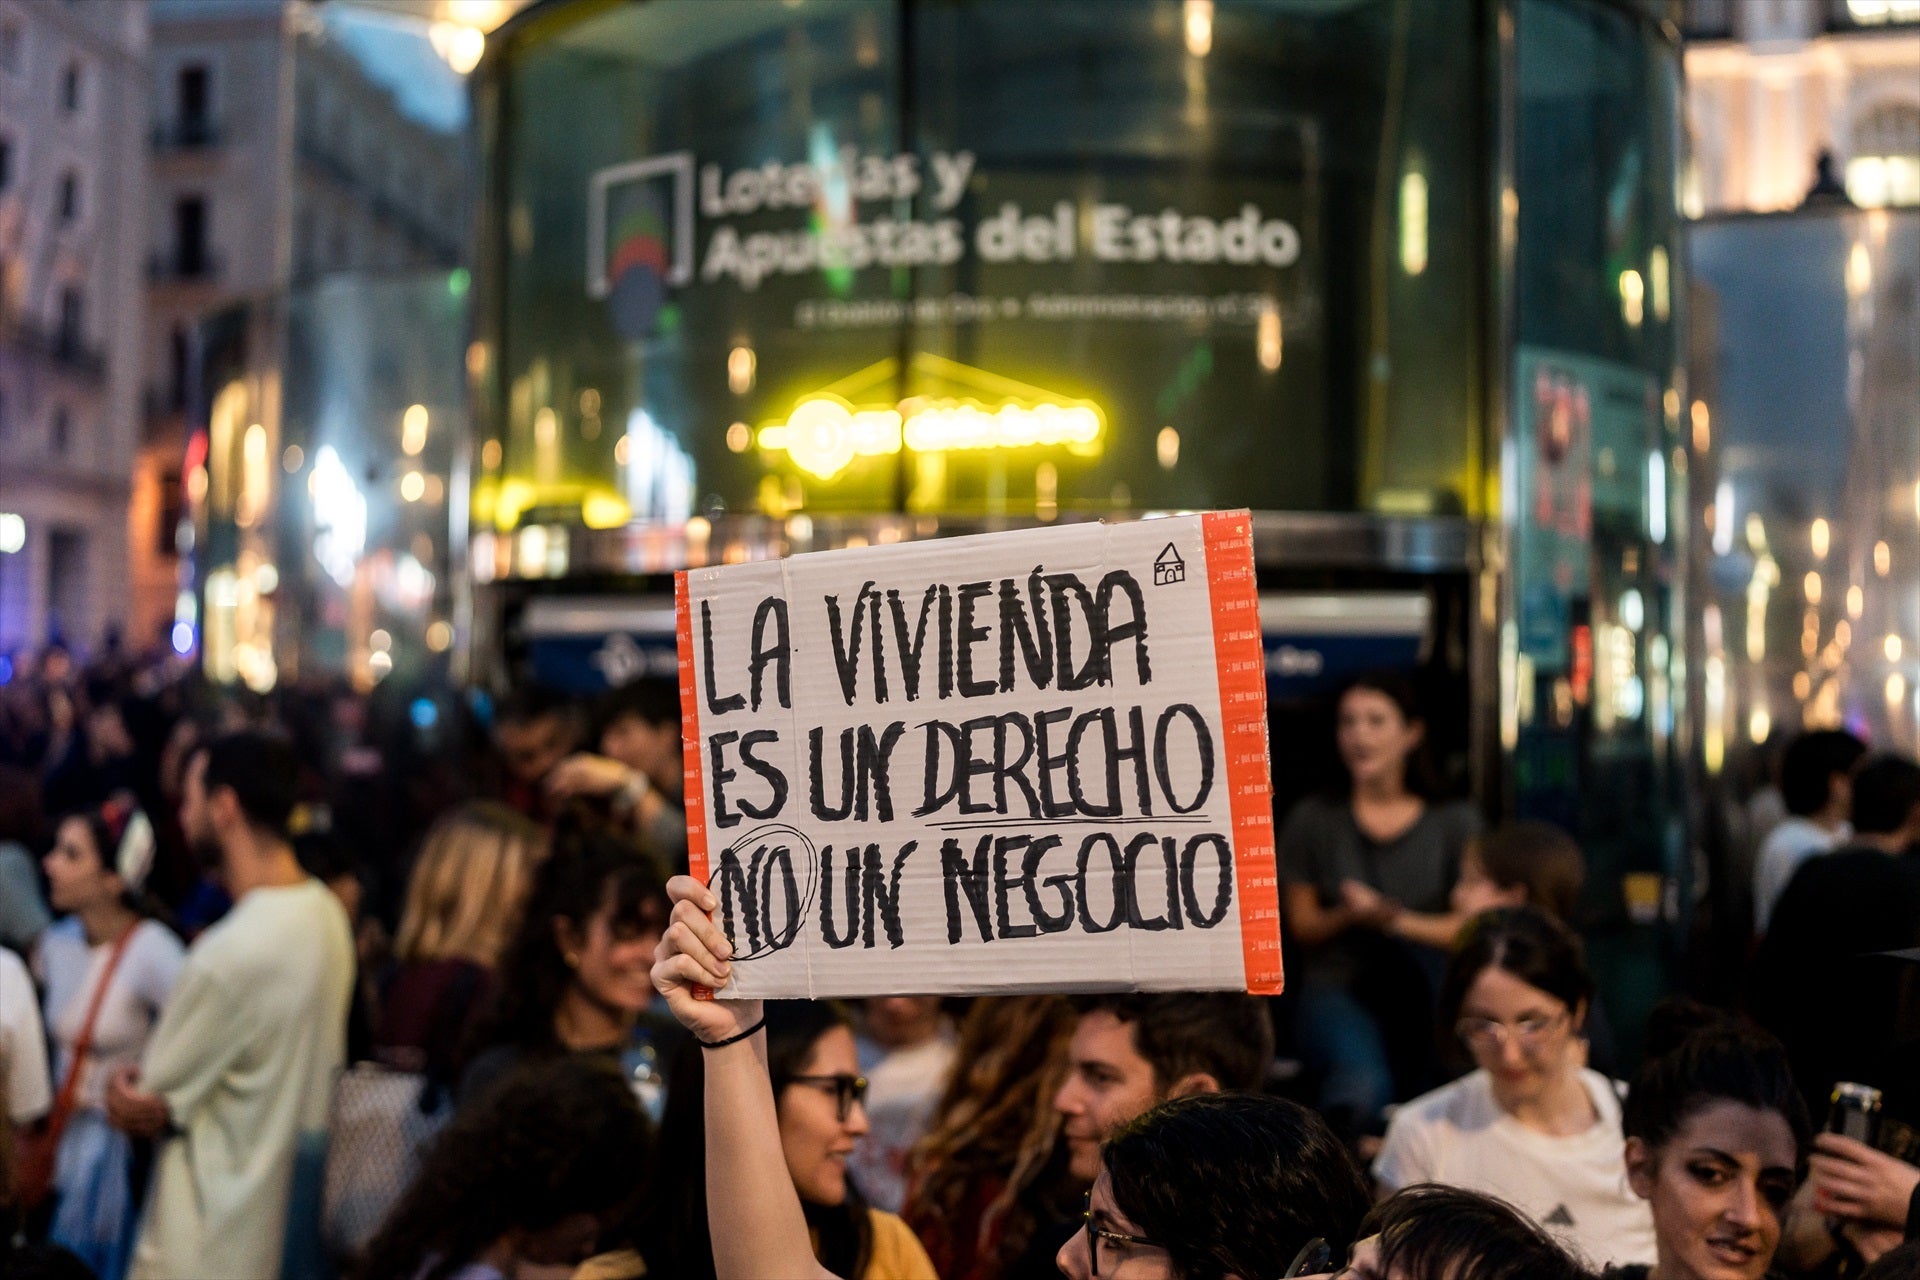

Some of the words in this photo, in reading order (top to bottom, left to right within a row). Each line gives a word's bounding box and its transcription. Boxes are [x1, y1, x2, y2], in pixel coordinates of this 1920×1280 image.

[929, 149, 976, 209] y
[701, 217, 964, 290] Apuestas
[975, 201, 1076, 263] del
[1095, 203, 1300, 267] Estado
[702, 596, 792, 715] LA
[825, 565, 1153, 706] VIVIENDA
[709, 729, 790, 829] ES
[809, 721, 907, 823] UN
[911, 703, 1215, 819] DERECHO
[719, 844, 799, 956] NO
[820, 839, 918, 950] UN
[940, 832, 1233, 945] NEGOCIO
